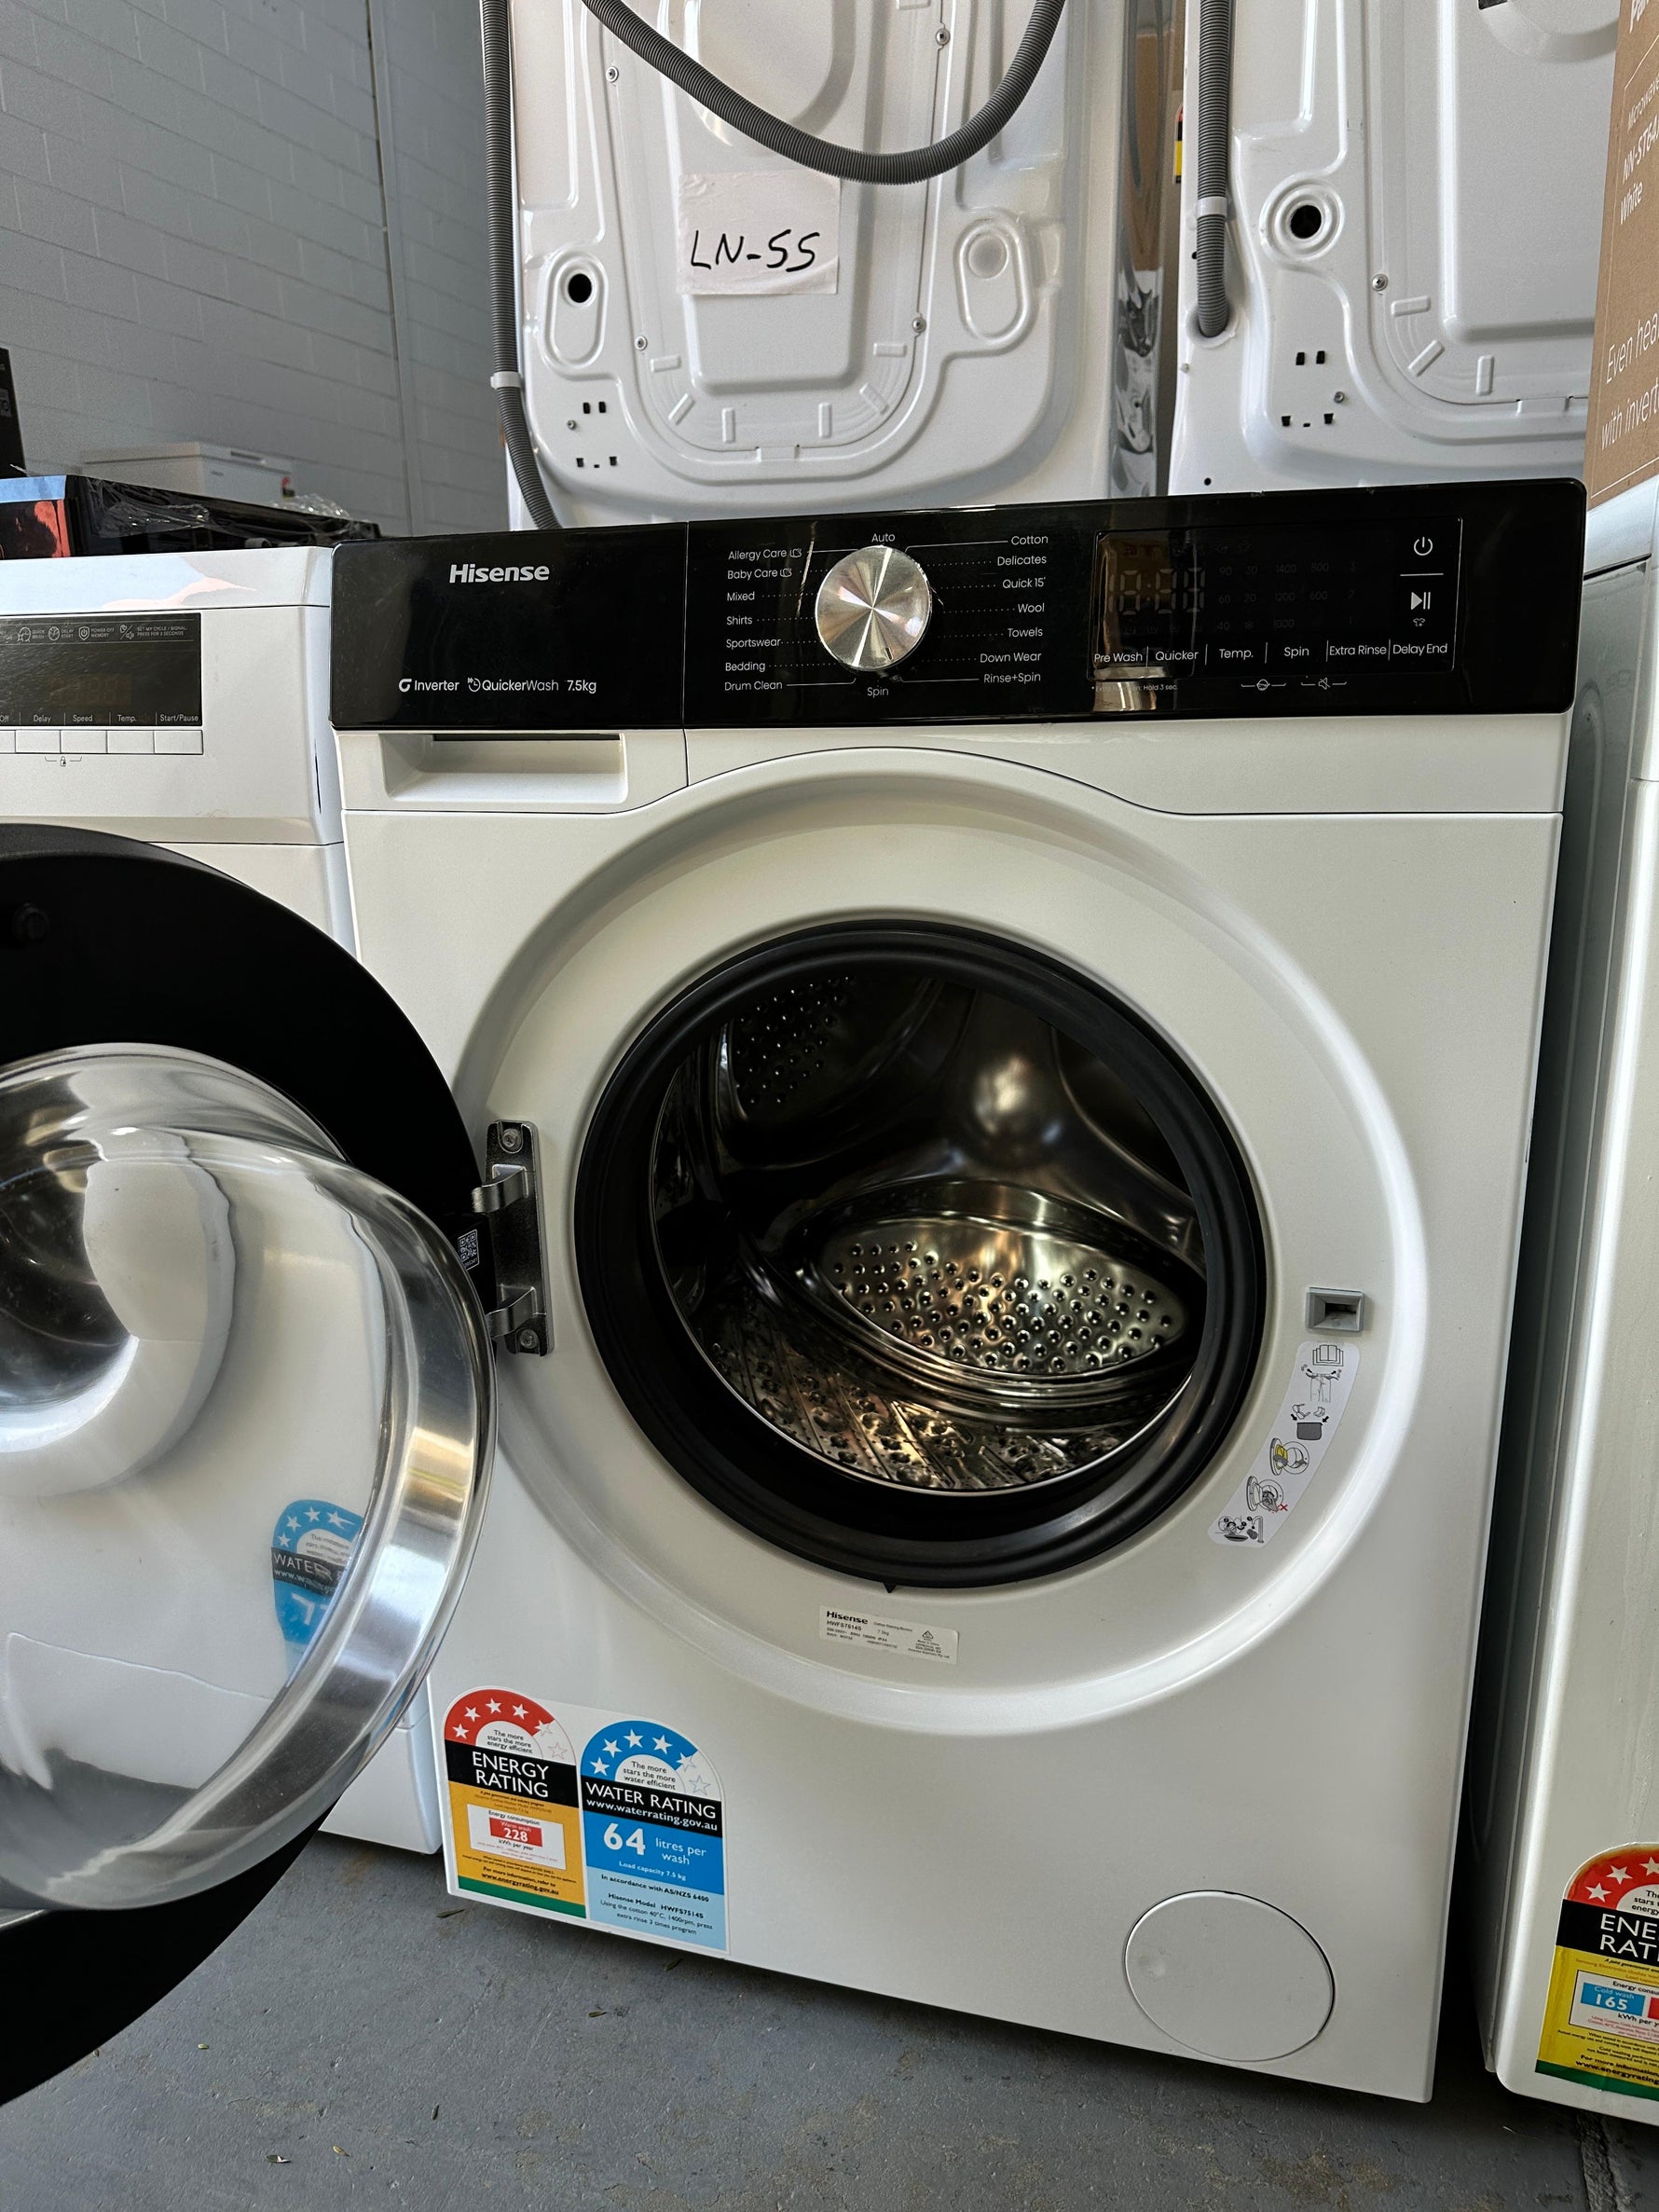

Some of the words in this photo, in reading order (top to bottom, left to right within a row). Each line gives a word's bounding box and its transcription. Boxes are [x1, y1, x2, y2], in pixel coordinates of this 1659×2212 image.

[1620, 182, 1643, 226] White
[1606, 336, 1633, 384] Even
[1635, 312, 1659, 359] hea
[1601, 405, 1623, 450] with
[1625, 377, 1659, 434] invert
[871, 533, 897, 543] Auto
[1011, 535, 1049, 545] Cotton
[728, 550, 761, 561] Allergy
[762, 548, 788, 558] Care
[997, 555, 1047, 566] Delicates
[449, 563, 550, 584] Hisense
[727, 570, 752, 581] Baby
[754, 568, 778, 578] Care
[1002, 578, 1033, 589] Quick
[726, 591, 755, 601] Mixed
[1017, 602, 1045, 613] Wool
[726, 615, 753, 625] Shirts
[1008, 626, 1043, 638] Towels
[725, 639, 781, 650] Sportswear
[1329, 645, 1355, 656] Extra
[1358, 644, 1387, 655] Rinse
[1392, 643, 1425, 656] Delay
[1426, 642, 1447, 654] End
[980, 653, 1011, 663] Down
[1013, 652, 1042, 662] Wear
[1094, 653, 1111, 664] Pre
[1113, 653, 1143, 663] Wash
[1155, 650, 1199, 662] Quicker
[1219, 648, 1254, 659] Temp.
[1283, 646, 1309, 659] Spin
[725, 662, 766, 672] Bedding
[983, 672, 1041, 684] Rinse+Spin
[414, 679, 460, 692] Inverter
[482, 678, 559, 692] QuickerWash
[567, 679, 596, 694] 7.5kg
[724, 681, 752, 691] Drum
[753, 680, 783, 690] Clean
[867, 687, 889, 698] Spin
[33, 714, 51, 723] Delay
[73, 714, 93, 723] Speed
[117, 714, 137, 723] Temp.
[160, 713, 199, 722] Start/Pause
[827, 1611, 869, 1625] Hisense
[494, 1729, 506, 1738] The
[487, 1741, 508, 1751] energy
[472, 1752, 549, 1780] ENERGY
[631, 1760, 646, 1770] The
[647, 1765, 667, 1774] more
[623, 1768, 641, 1777] stars
[656, 1774, 677, 1783] more
[475, 1770, 549, 1797] RATING
[624, 1775, 645, 1784] water
[647, 1779, 677, 1791] efficient
[585, 1781, 645, 1806] WATER
[651, 1793, 716, 1820] RATING
[487, 1810, 507, 1820] Energy
[586, 1799, 718, 1832] www.waterrating.gov.au
[503, 1827, 529, 1843] 228
[603, 1822, 646, 1856] 64
[655, 1837, 684, 1852] litres
[688, 1845, 706, 1857] per
[662, 1852, 690, 1865] wash
[619, 1861, 636, 1870] Load
[637, 1865, 665, 1876] capacity
[678, 1873, 687, 1881] kg
[610, 1875, 647, 1889] accordance
[648, 1883, 664, 1892] with
[664, 1888, 692, 1899] AS/NZS
[600, 1899, 617, 1909] Using
[608, 1892, 634, 1903] Hisense
[636, 1898, 656, 1908] Model
[1634, 1897, 1655, 1906] stars
[1631, 1903, 1659, 1916] energy
[1600, 1913, 1659, 1941] ENE
[1594, 1985, 1613, 1995] Cold
[1615, 1991, 1635, 1999] wash
[1612, 1981, 1637, 1991] Energy
[1596, 1993, 1628, 2011] 165
[1617, 2013, 1637, 2022] kWh
[1638, 2017, 1652, 2026] per
[1595, 2058, 1614, 2067] more
